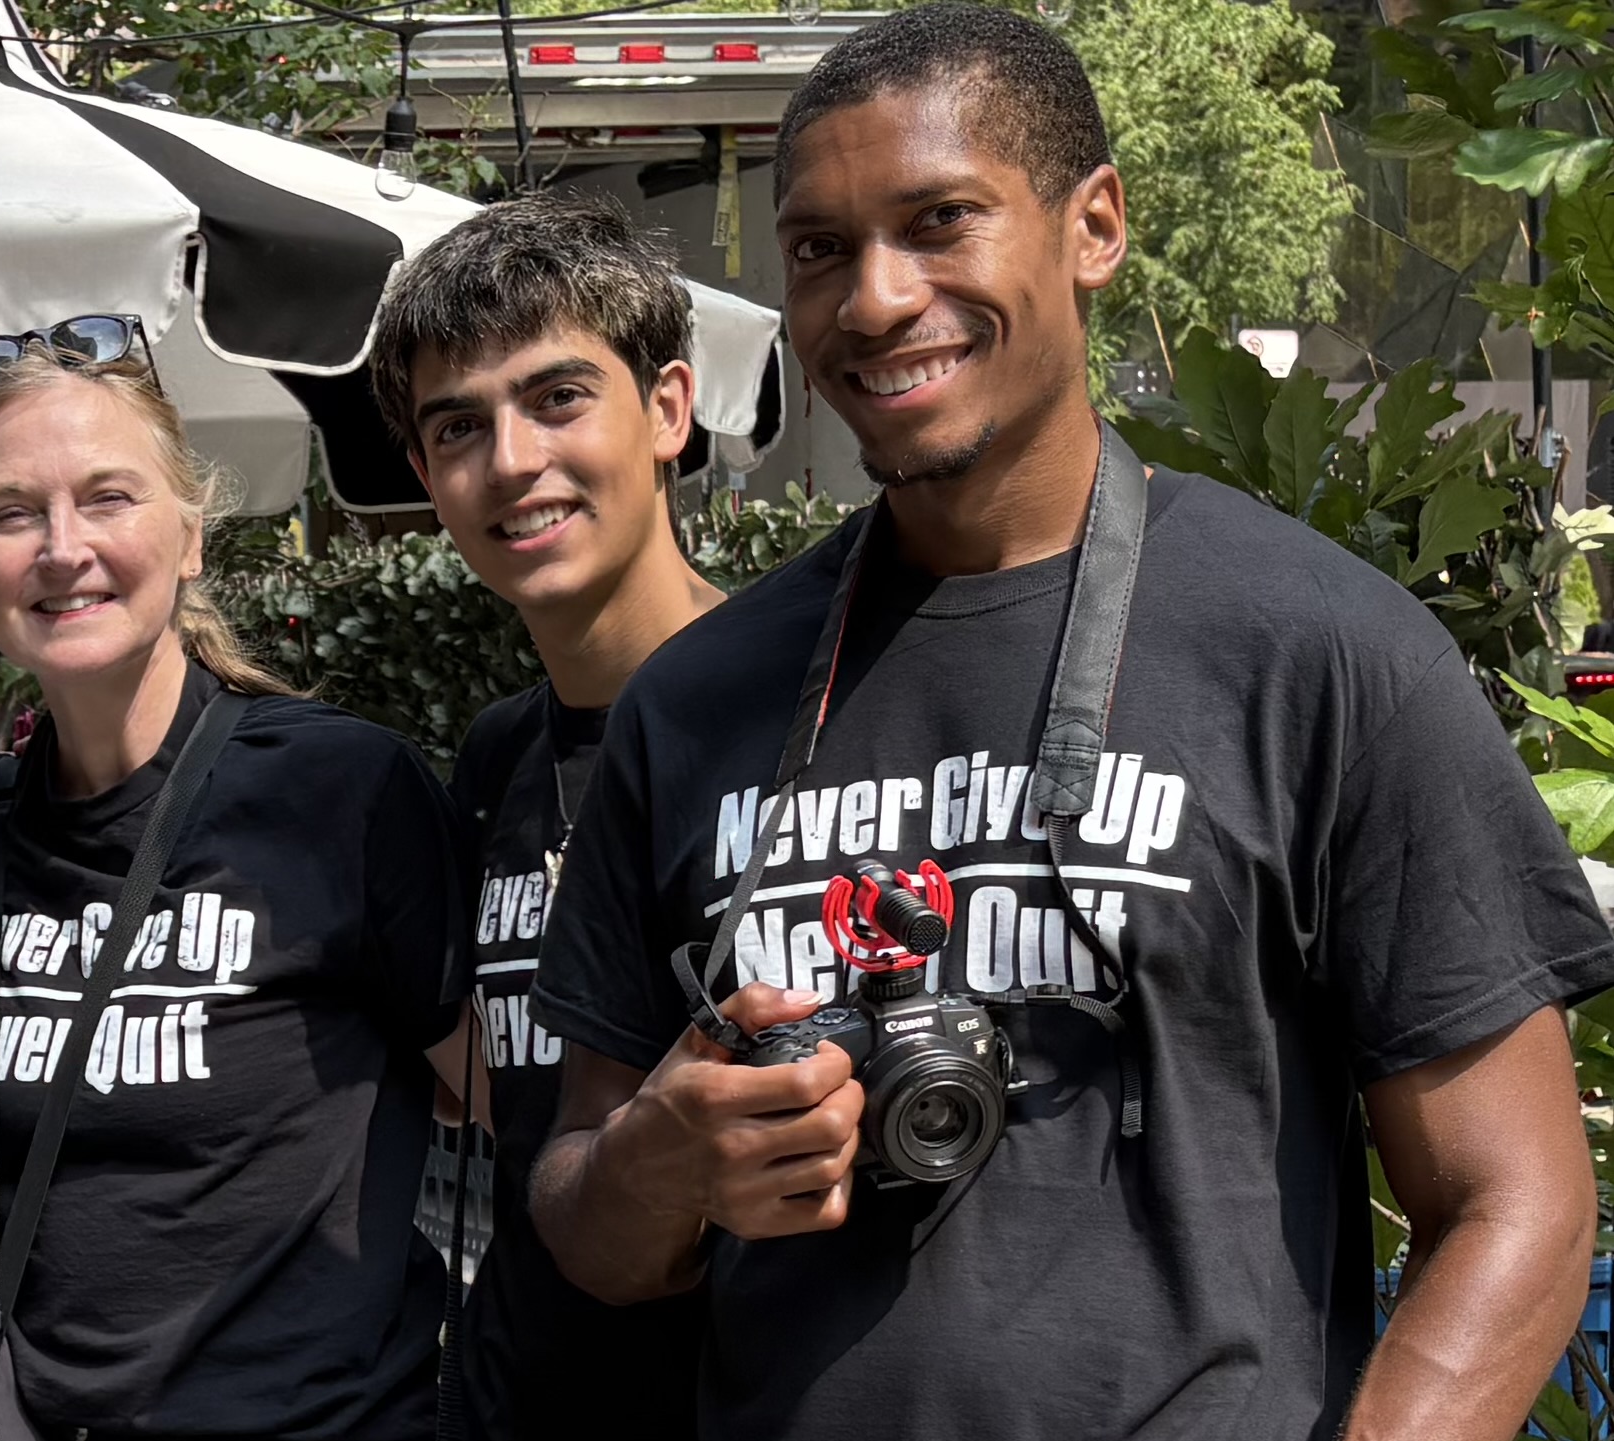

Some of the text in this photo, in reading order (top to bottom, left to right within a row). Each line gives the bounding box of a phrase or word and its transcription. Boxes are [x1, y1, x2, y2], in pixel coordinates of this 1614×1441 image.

[1079, 752, 1186, 865] Up
[177, 892, 255, 985] Up
[85, 1001, 211, 1095] Quit
[885, 1015, 980, 1034] Canon EOS
